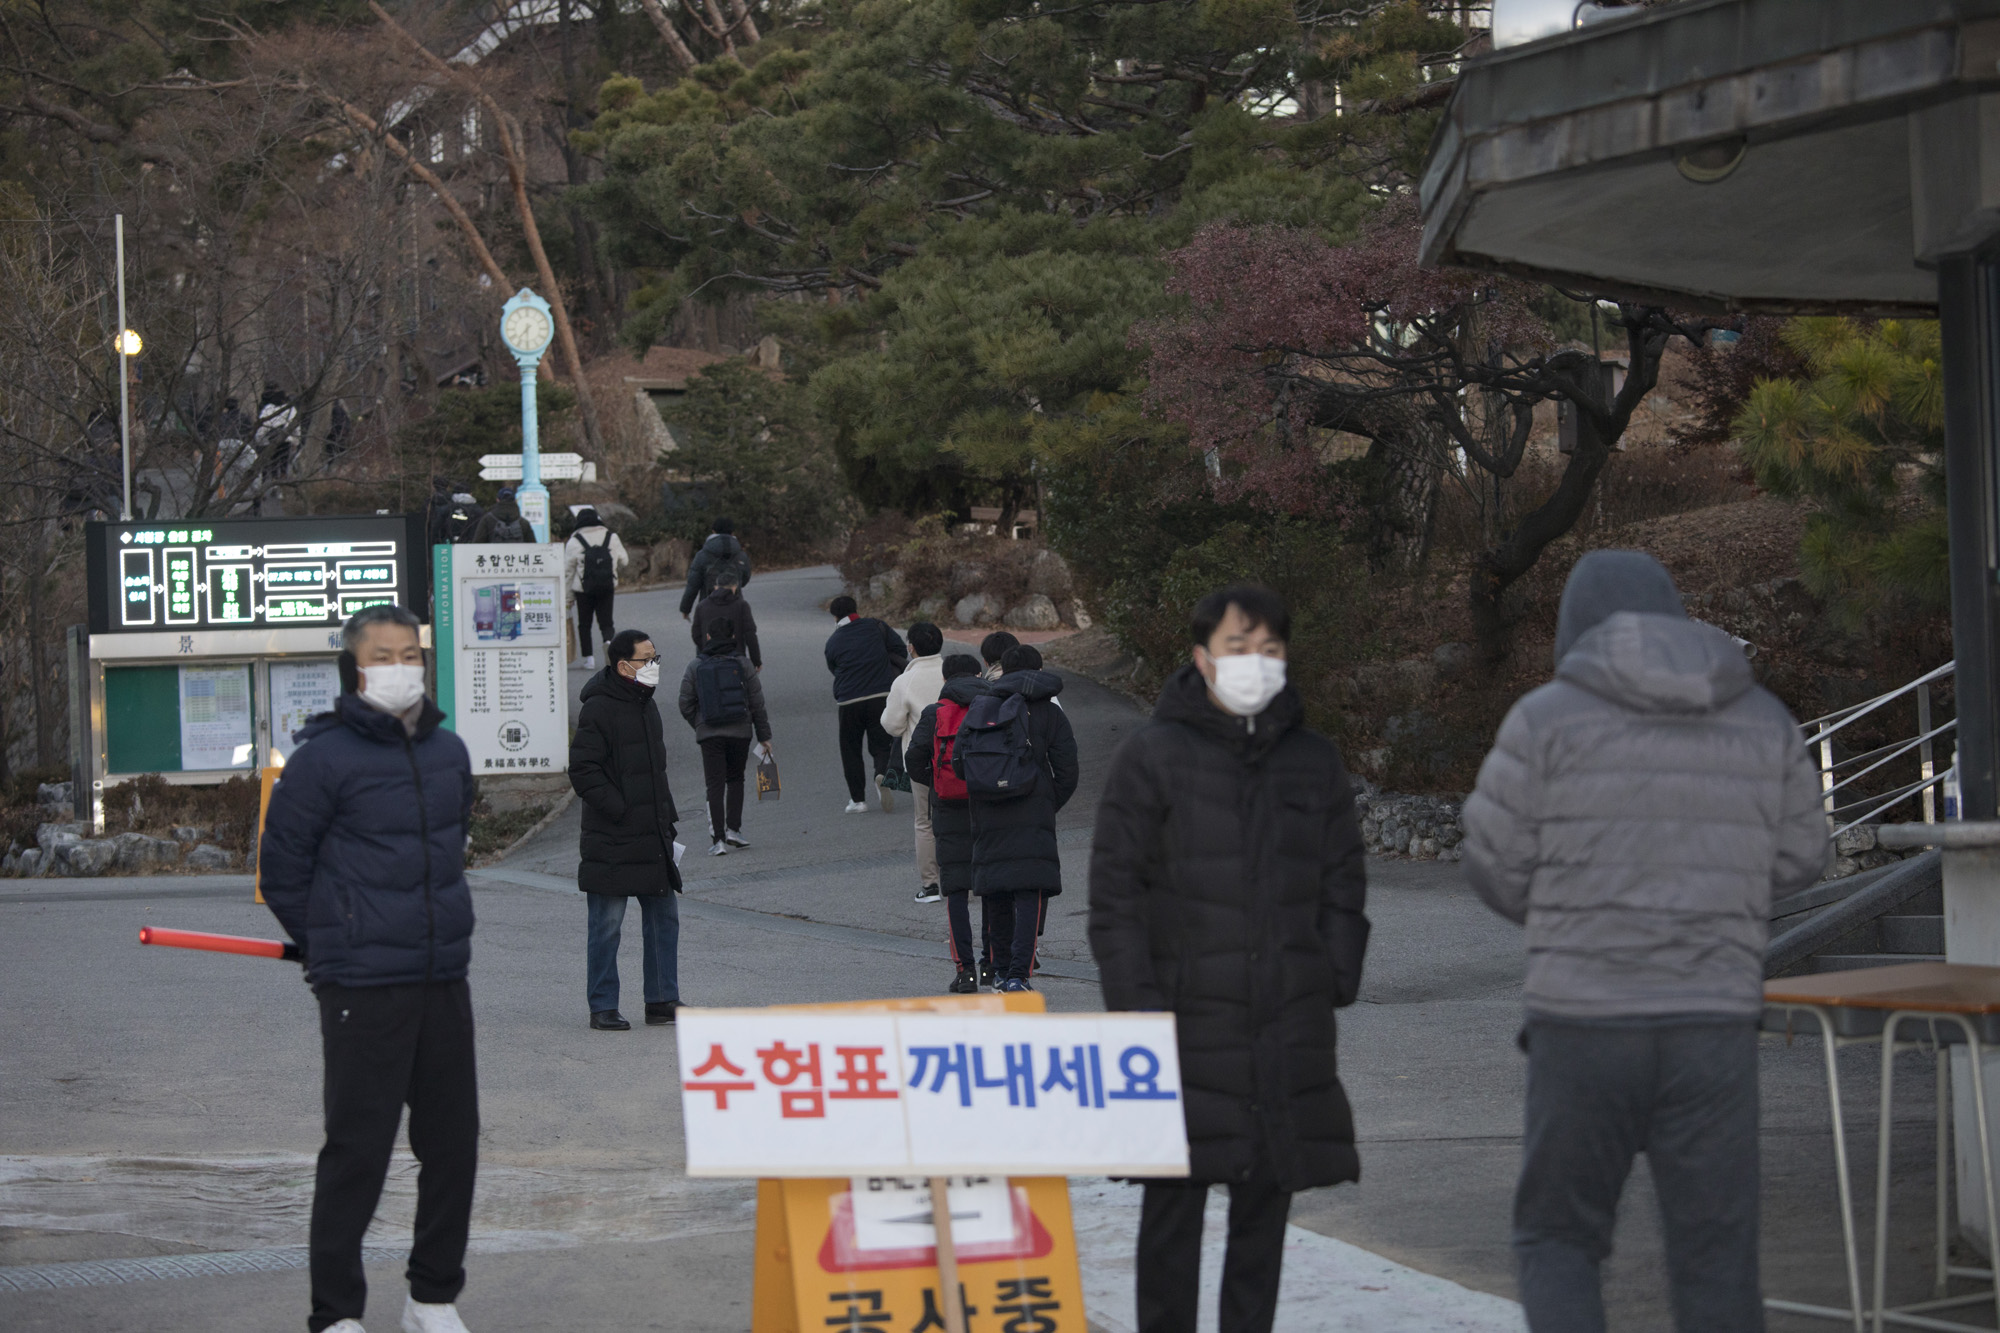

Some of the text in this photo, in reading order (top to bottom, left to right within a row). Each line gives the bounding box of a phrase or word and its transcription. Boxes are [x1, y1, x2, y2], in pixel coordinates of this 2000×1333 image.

[441, 548, 450, 627] INFORMATION
[476, 554, 544, 568] 종합안내도
[484, 757, 551, 768] 景福高等學校
[684, 1040, 1177, 1118] 수험표 꺼내세요
[825, 1277, 1061, 1333] 공사중
